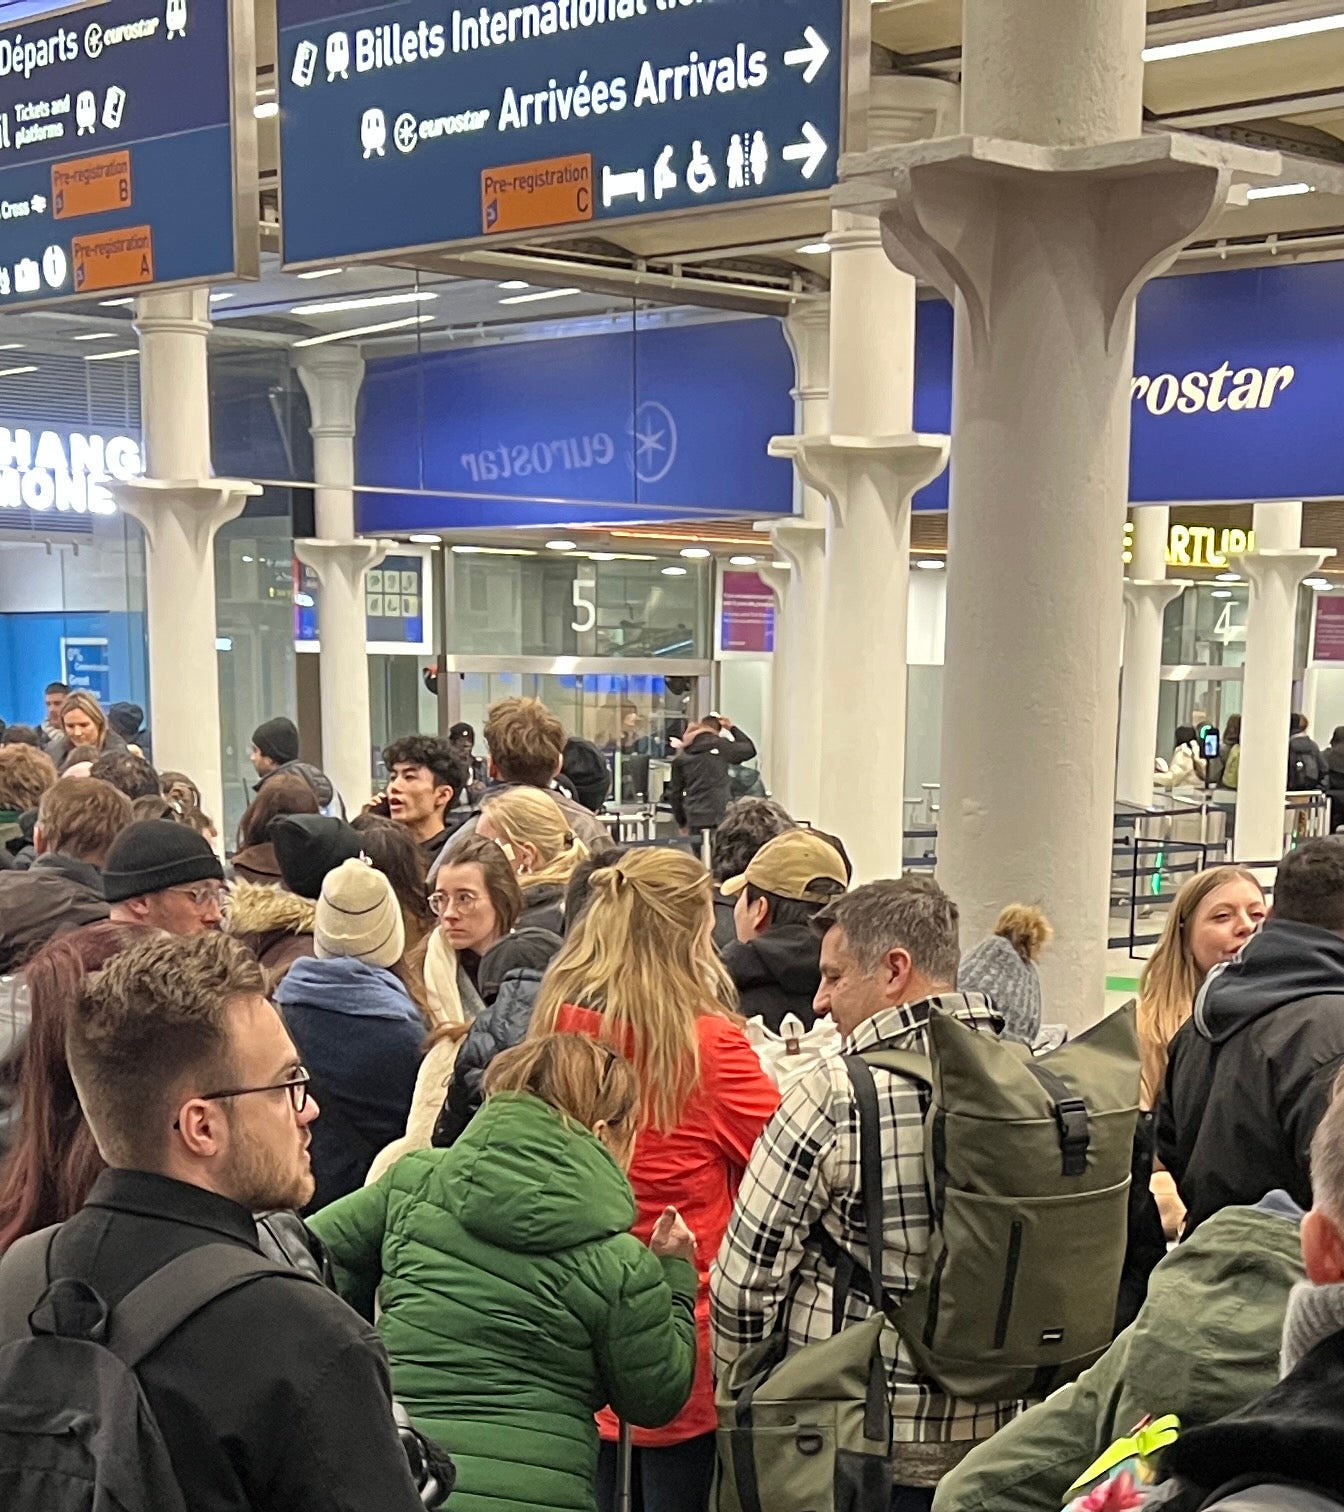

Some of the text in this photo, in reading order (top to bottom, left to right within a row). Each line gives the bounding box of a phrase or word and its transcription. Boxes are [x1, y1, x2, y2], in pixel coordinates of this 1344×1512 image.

[103, 16, 160, 47] eurostar
[356, 20, 446, 73] Billets
[418, 42, 768, 139] eurostar Arrivées Arrivals
[14, 101, 50, 123] Tickets
[51, 93, 71, 115] and
[14, 121, 64, 150] platforms
[53, 158, 128, 187] Pre-registration
[484, 163, 589, 196] Pre-registration
[119, 178, 129, 202] B
[576, 187, 590, 213] C
[73, 235, 149, 260] Pre-registration
[140, 254, 150, 277] A
[571, 578, 596, 632] 5
[1213, 601, 1240, 646] 4
